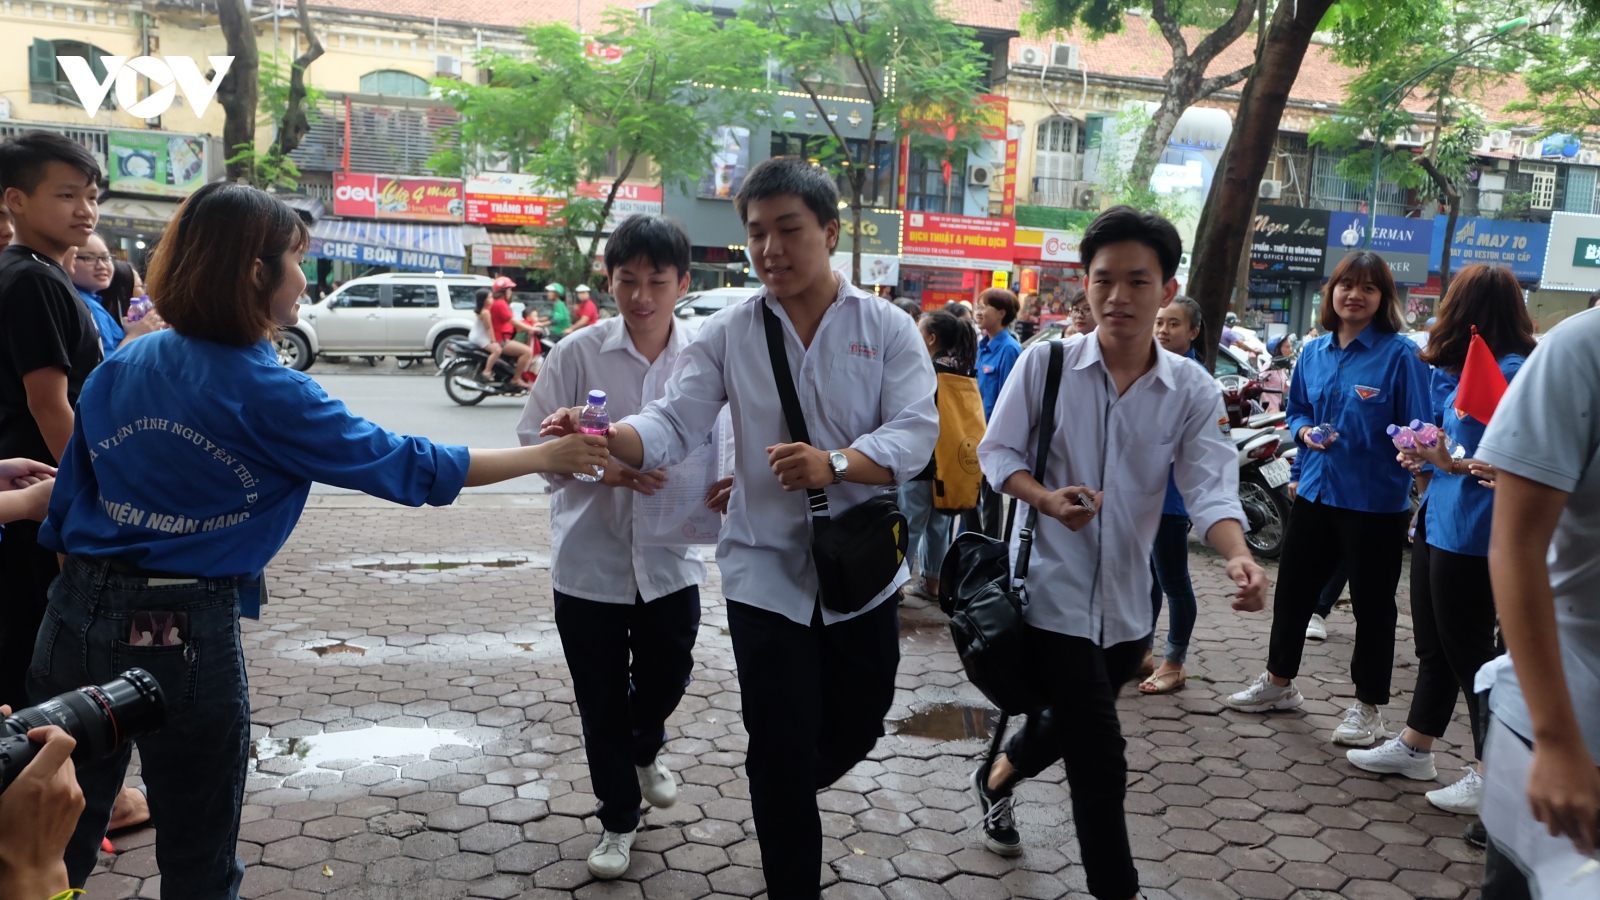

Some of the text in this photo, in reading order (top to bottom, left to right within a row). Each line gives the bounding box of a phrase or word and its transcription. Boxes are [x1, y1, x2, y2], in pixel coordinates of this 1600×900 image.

[412, 185, 426, 204] 4
[909, 231, 929, 243] DỊCH
[930, 231, 955, 246] THUẬT
[988, 237, 1007, 249] DỊCH
[1476, 233, 1528, 249] MAY 10
[1263, 253, 1284, 261] OFFICE
[1285, 254, 1321, 264] EQUIPMENT
[1474, 250, 1500, 260] VESTON
[1502, 252, 1515, 261] CAO
[1387, 261, 1410, 272] RKER
[135, 415, 169, 431] TÌNH
[170, 422, 237, 466] NGUYỆN
[233, 463, 260, 489] THỦ
[145, 512, 200, 534] NGÂN
